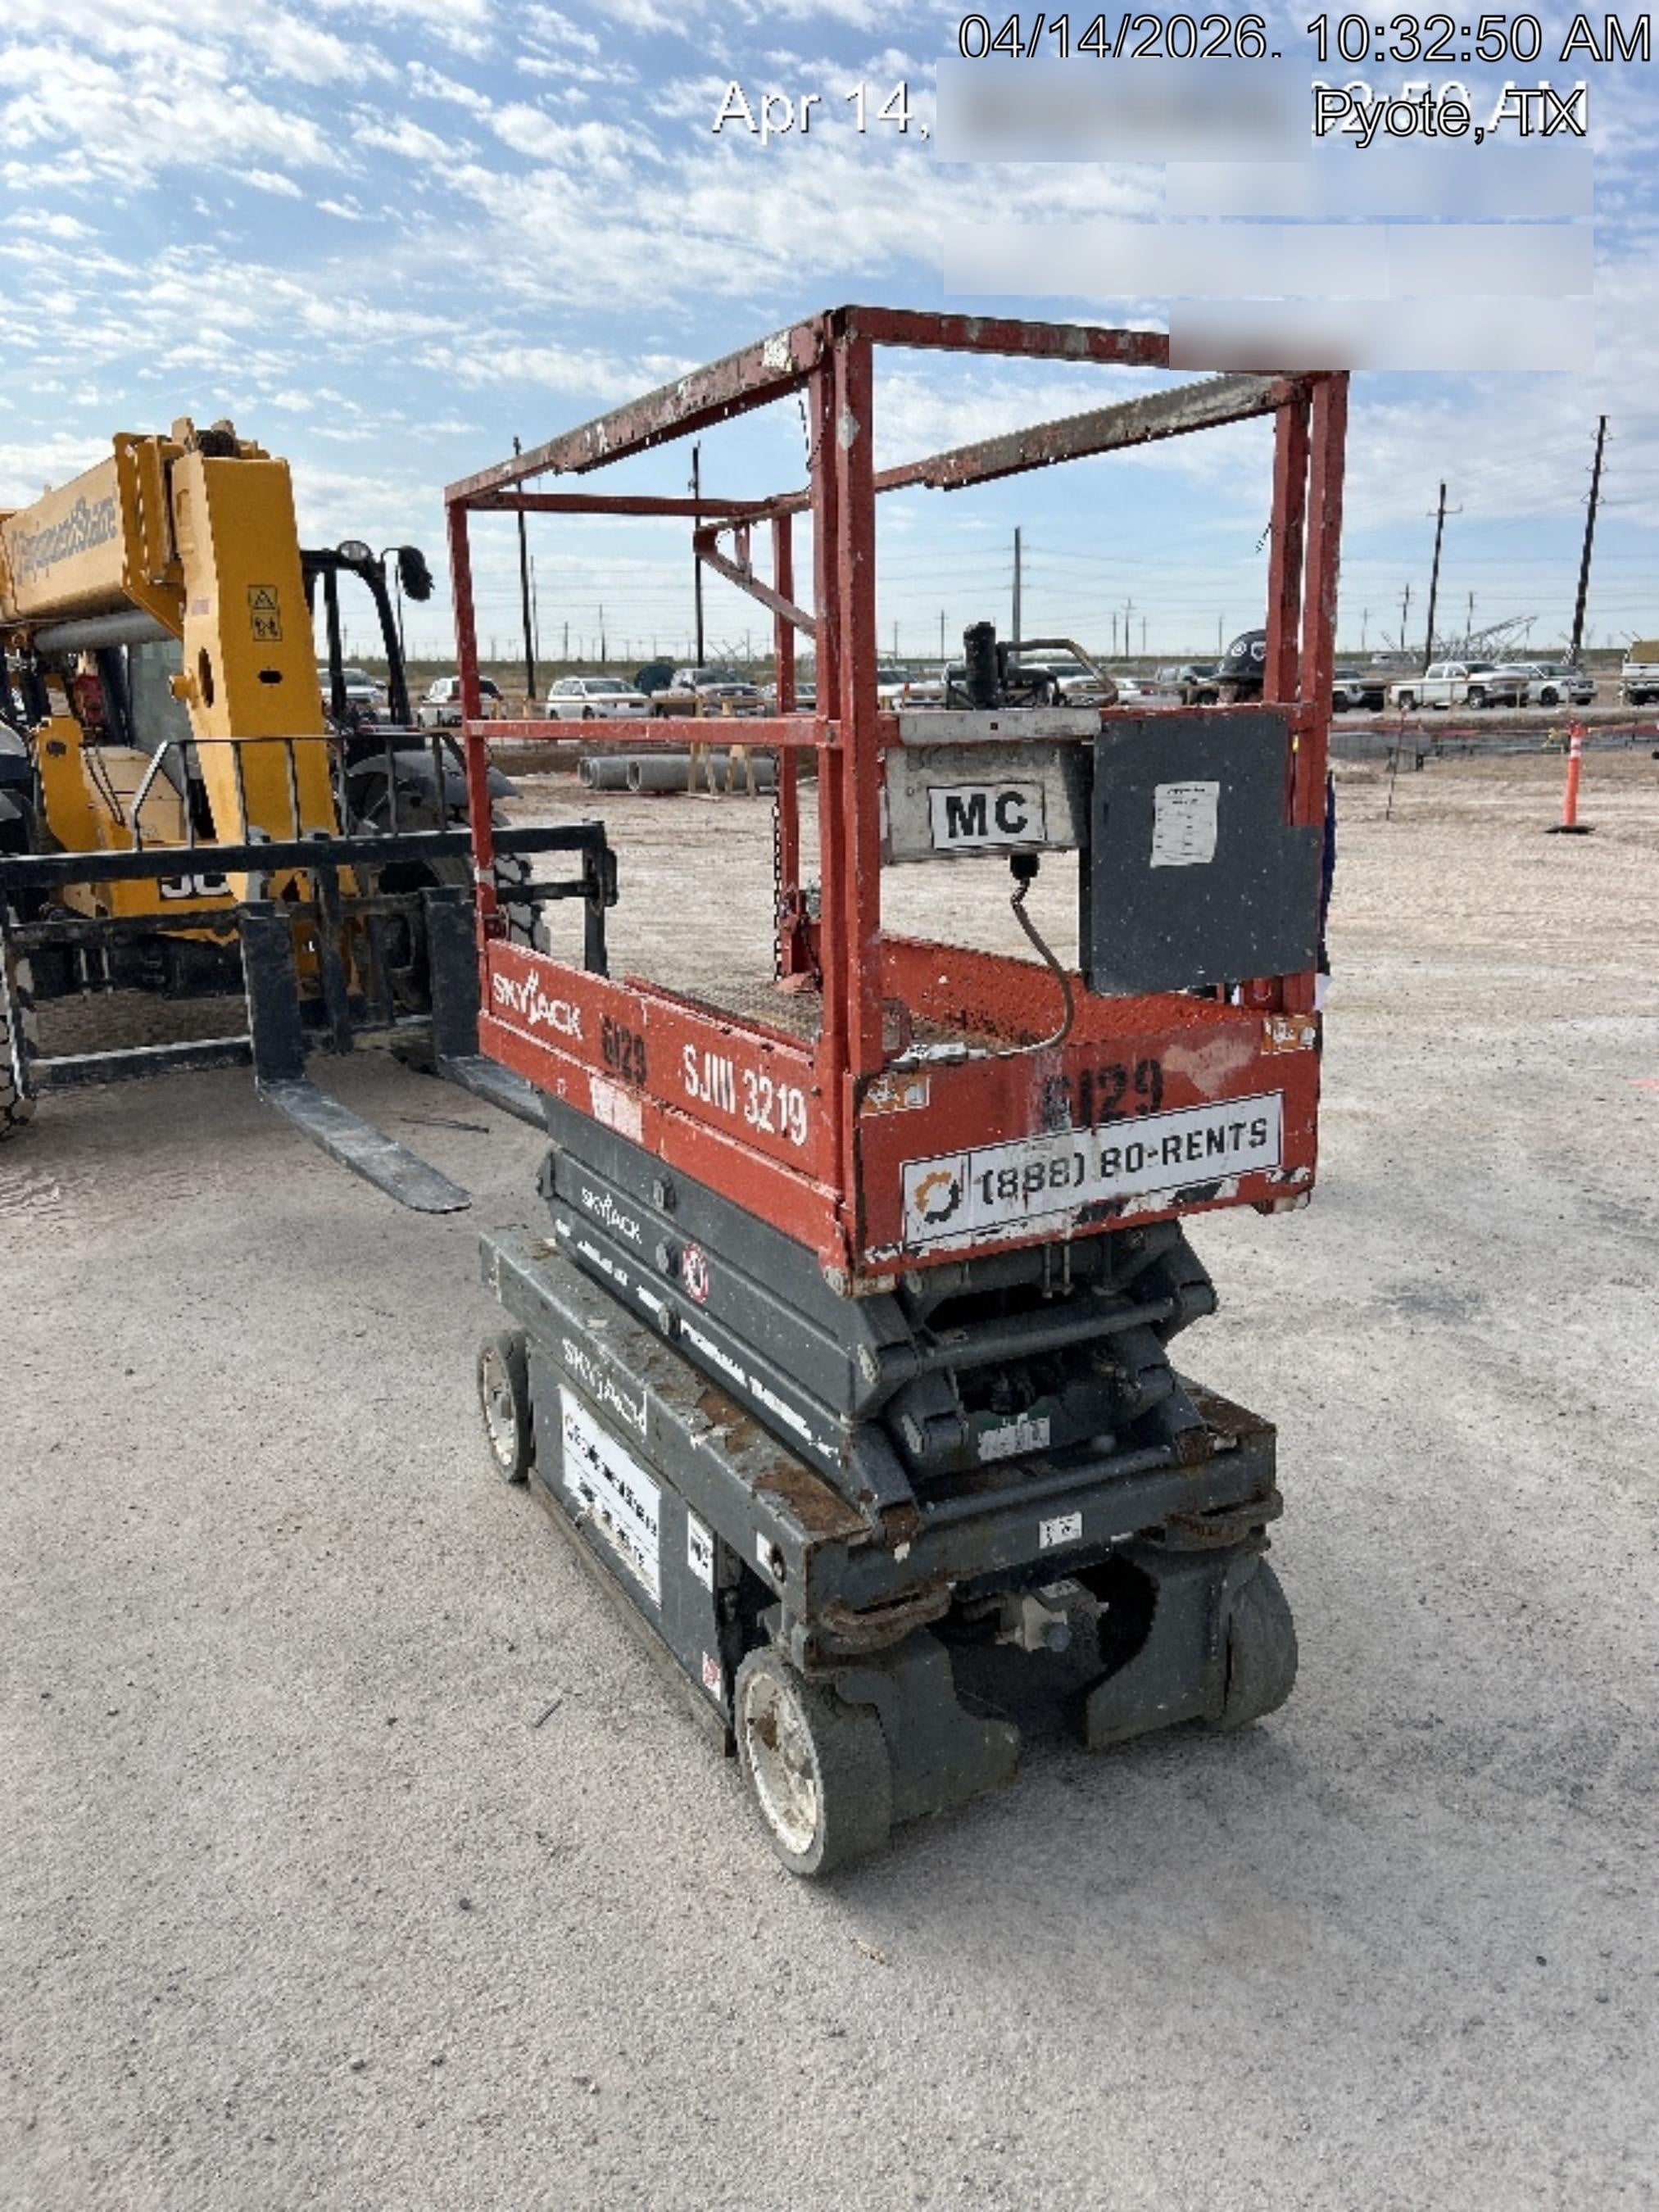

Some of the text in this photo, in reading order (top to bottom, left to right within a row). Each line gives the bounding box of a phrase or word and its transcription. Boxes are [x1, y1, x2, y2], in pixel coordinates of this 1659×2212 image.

[946, 791, 1028, 839] MC
[493, 968, 582, 1040] SKYJACK
[742, 1068, 807, 1145] 3219
[983, 1153, 1085, 1205] (888)
